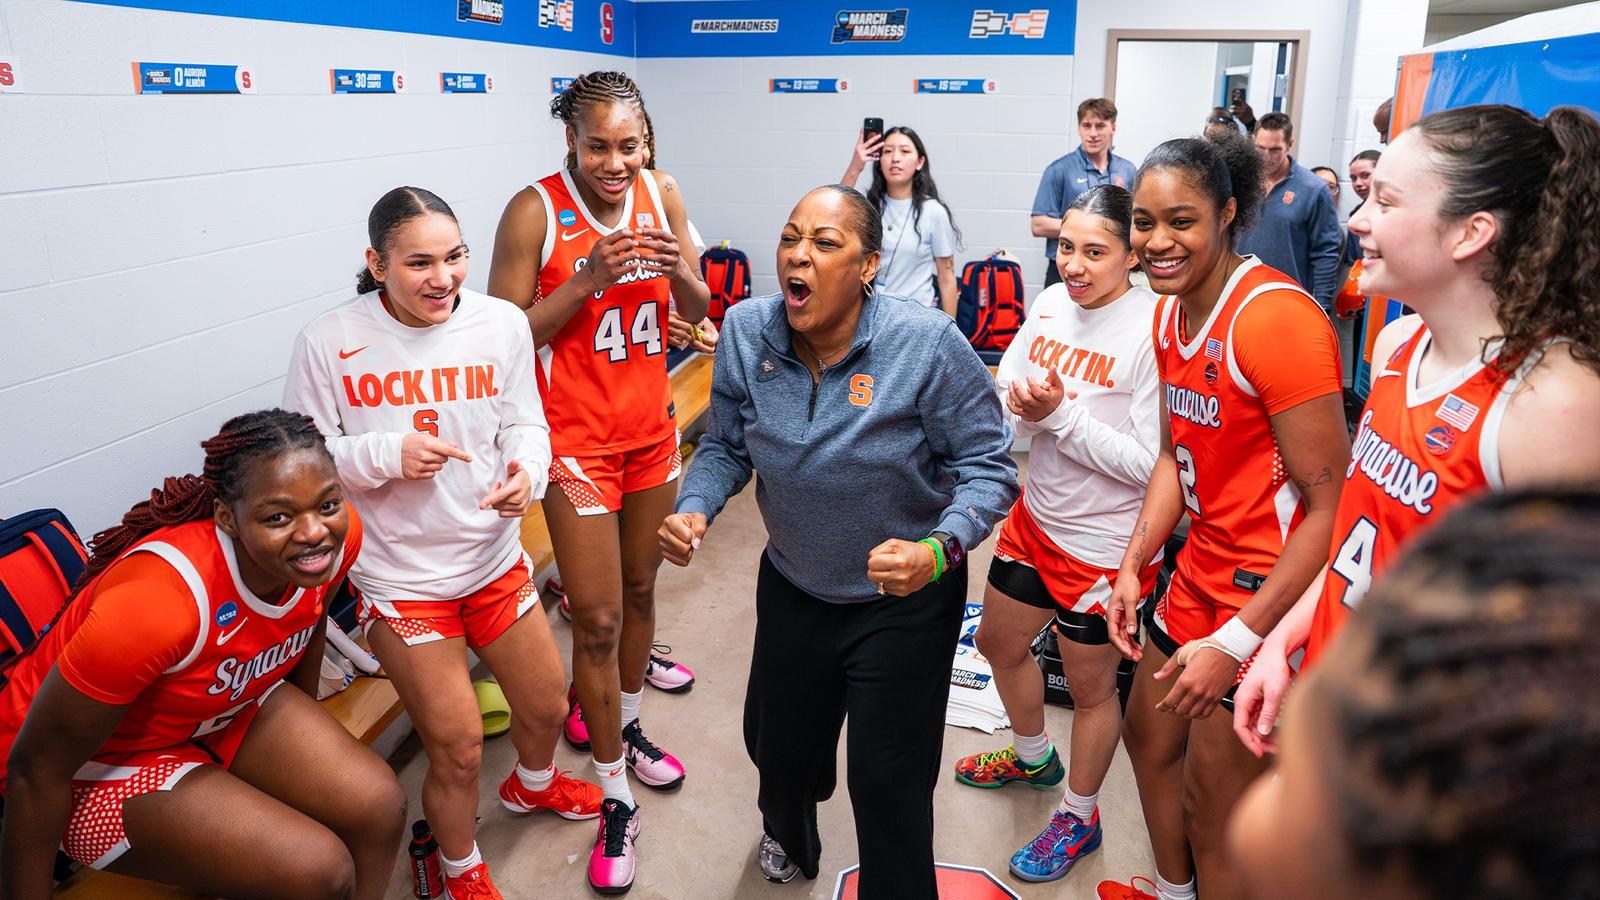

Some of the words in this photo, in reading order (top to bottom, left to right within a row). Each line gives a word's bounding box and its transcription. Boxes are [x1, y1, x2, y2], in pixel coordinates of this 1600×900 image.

[601, 3, 614, 45] S
[693, 21, 777, 31] #MARCHMADNESS
[848, 12, 888, 25] MARCH
[852, 24, 906, 37] MADNESS
[174, 67, 184, 87] 0
[241, 71, 251, 88] S
[355, 73, 367, 88] 30
[397, 75, 404, 90] S
[840, 81, 848, 91] S
[988, 81, 996, 92] S
[594, 301, 662, 363] 44
[1029, 336, 1069, 370] OCK
[1061, 347, 1090, 378] IT
[1082, 351, 1116, 389] IN.
[342, 369, 428, 407] LOCK
[432, 367, 460, 402] IT
[465, 364, 499, 399] IN.
[848, 373, 874, 407] S
[1347, 409, 1438, 514] Syracuse
[1174, 443, 1202, 516] 2
[1331, 516, 1379, 609] 4
